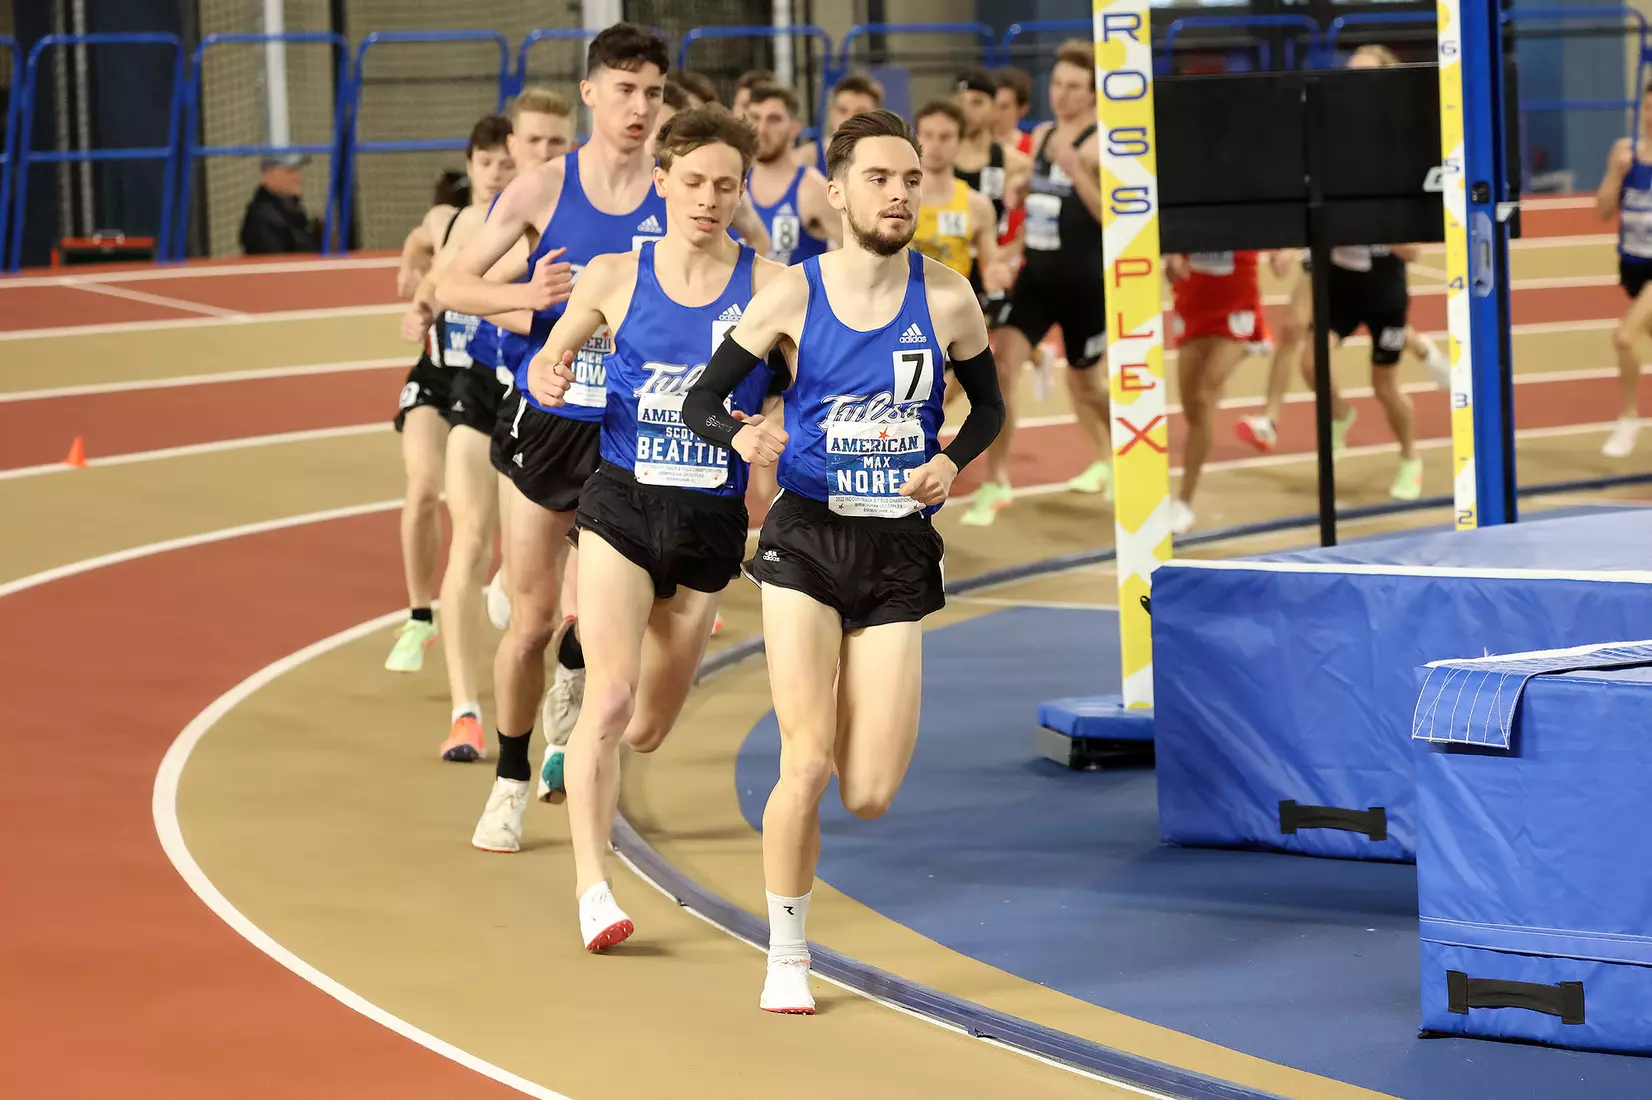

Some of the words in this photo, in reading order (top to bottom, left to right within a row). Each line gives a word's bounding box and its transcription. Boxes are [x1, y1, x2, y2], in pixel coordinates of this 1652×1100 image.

[1440, 40, 1458, 56] 6
[1443, 158, 1460, 173] 5
[779, 222, 793, 248] 8
[1448, 276, 1465, 290] 4
[899, 335, 927, 344] adidas
[901, 353, 924, 401] 7
[1453, 393, 1469, 409] 3
[817, 391, 926, 431] Tulsa
[637, 436, 729, 466] BEATTIE
[830, 435, 920, 453] AMERICAN
[863, 456, 891, 469] MAX
[1457, 510, 1474, 526] 2
